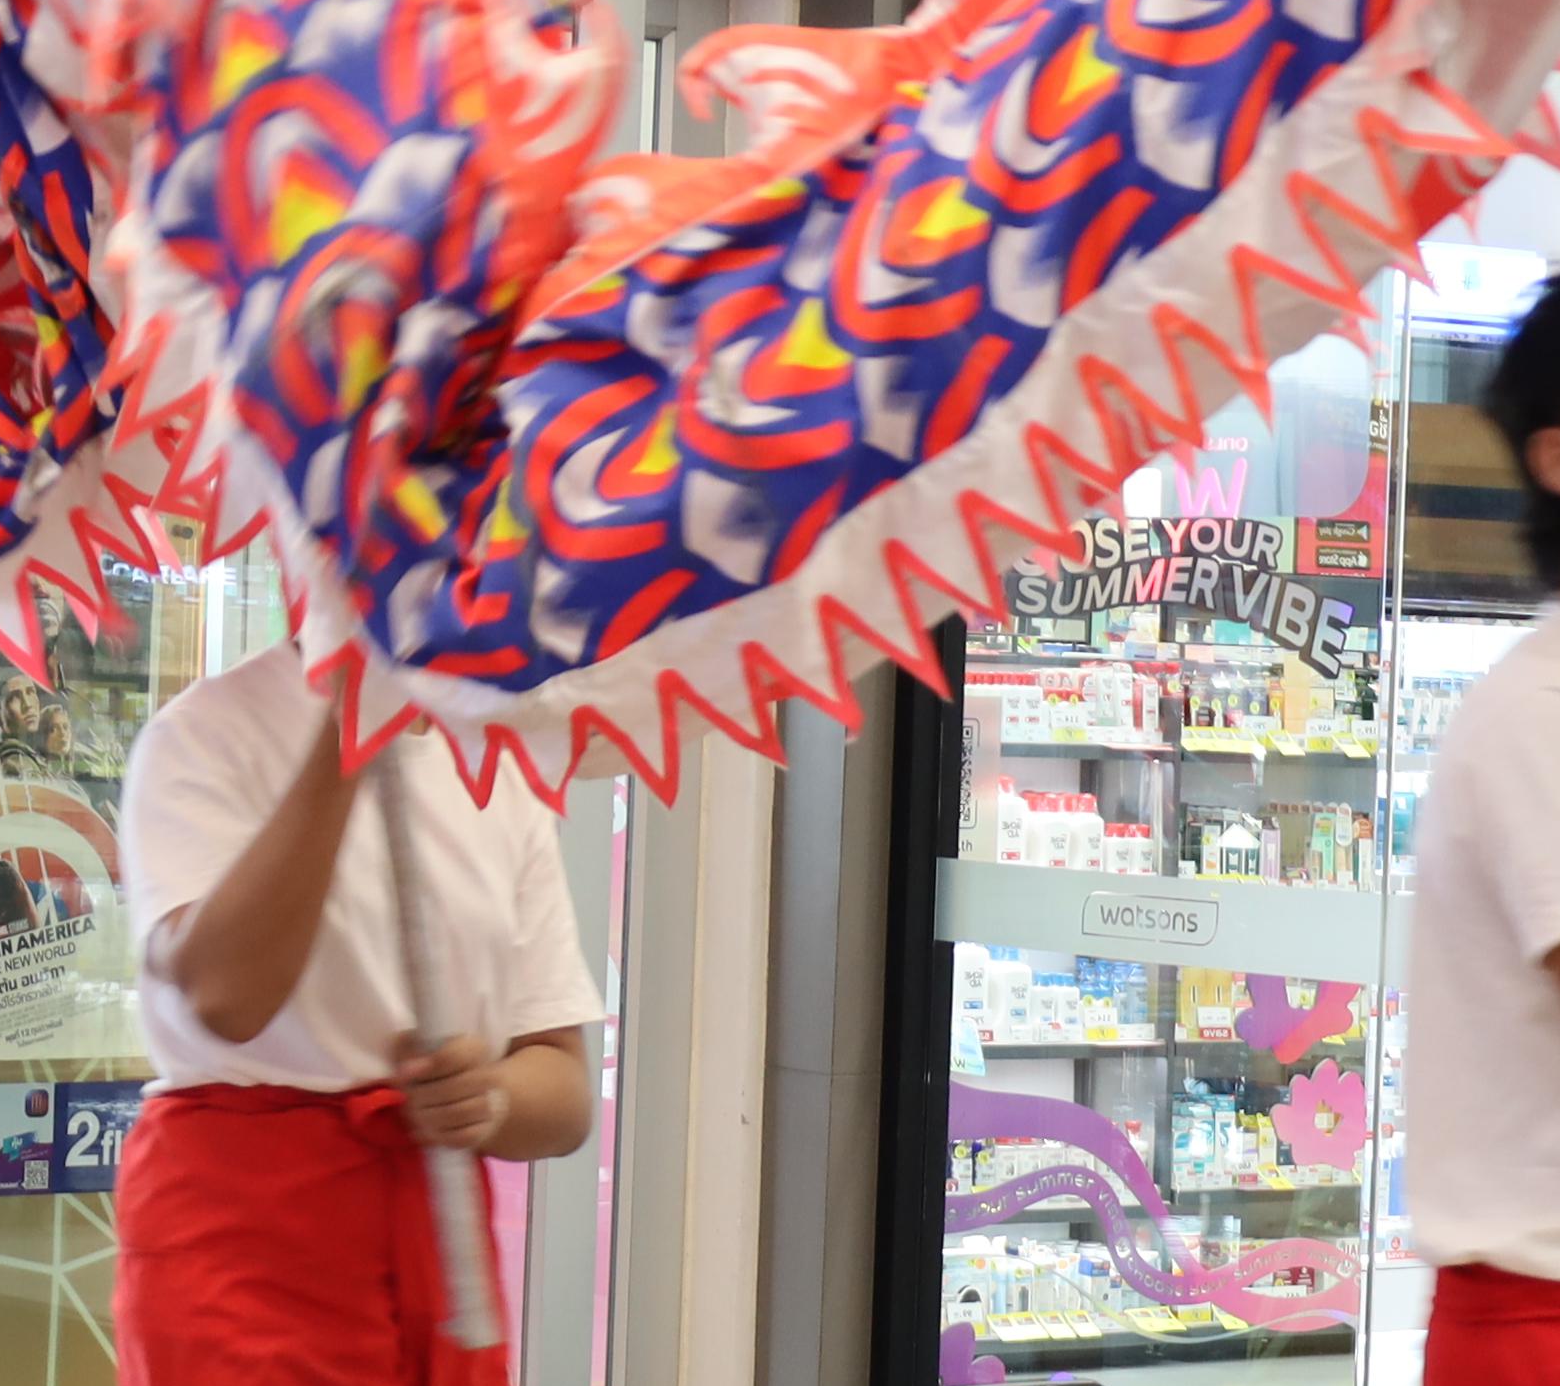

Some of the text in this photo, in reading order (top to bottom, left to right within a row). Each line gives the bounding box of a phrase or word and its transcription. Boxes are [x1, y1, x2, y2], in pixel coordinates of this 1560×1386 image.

[1160, 518, 1281, 570] YOUR
[1014, 555, 1355, 679] SUMMER VIBE
[16, 916, 97, 952] AMERICA
[1099, 902, 1199, 934] watsons
[4, 956, 31, 972] NEW
[33, 941, 77, 963] WORLD
[1015, 1171, 1097, 1201] summer
